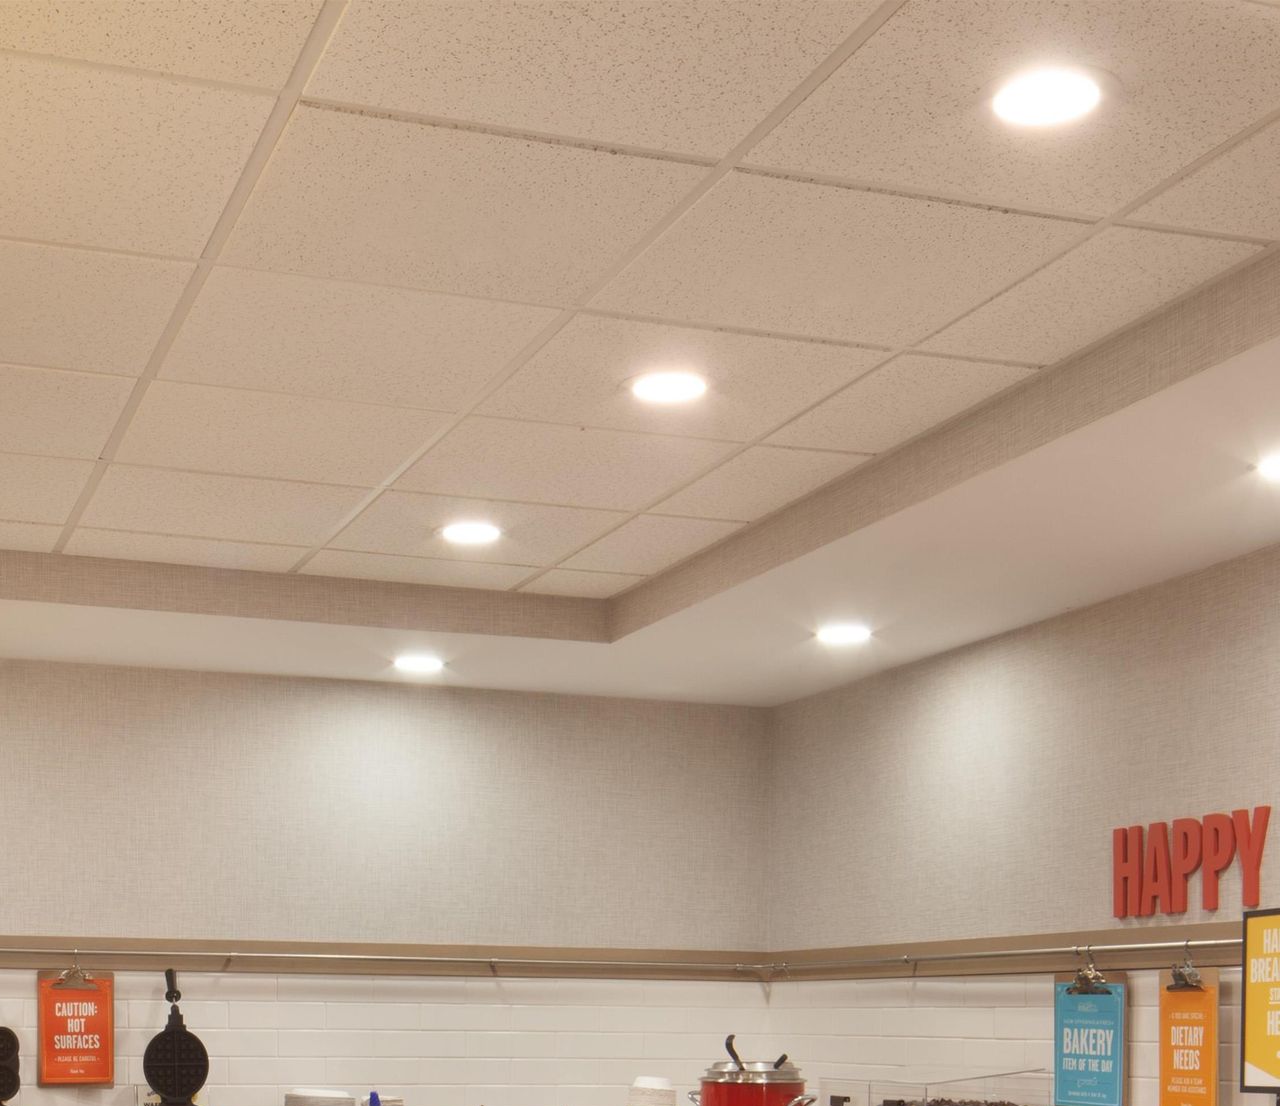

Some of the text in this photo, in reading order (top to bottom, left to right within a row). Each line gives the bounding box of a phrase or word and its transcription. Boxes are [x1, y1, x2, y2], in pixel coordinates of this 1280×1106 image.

[1113, 805, 1271, 918] HAPPY
[55, 1002, 98, 1017] CAUTION:
[67, 1018, 86, 1033] HOT
[54, 1034, 101, 1049] SURFACES
[1063, 1027, 1114, 1056] BAKERY
[1171, 1026, 1204, 1047] DIETARY
[1062, 1057, 1113, 1073] ITEM OF THE DAY
[1173, 1048, 1200, 1071] NEEDS
